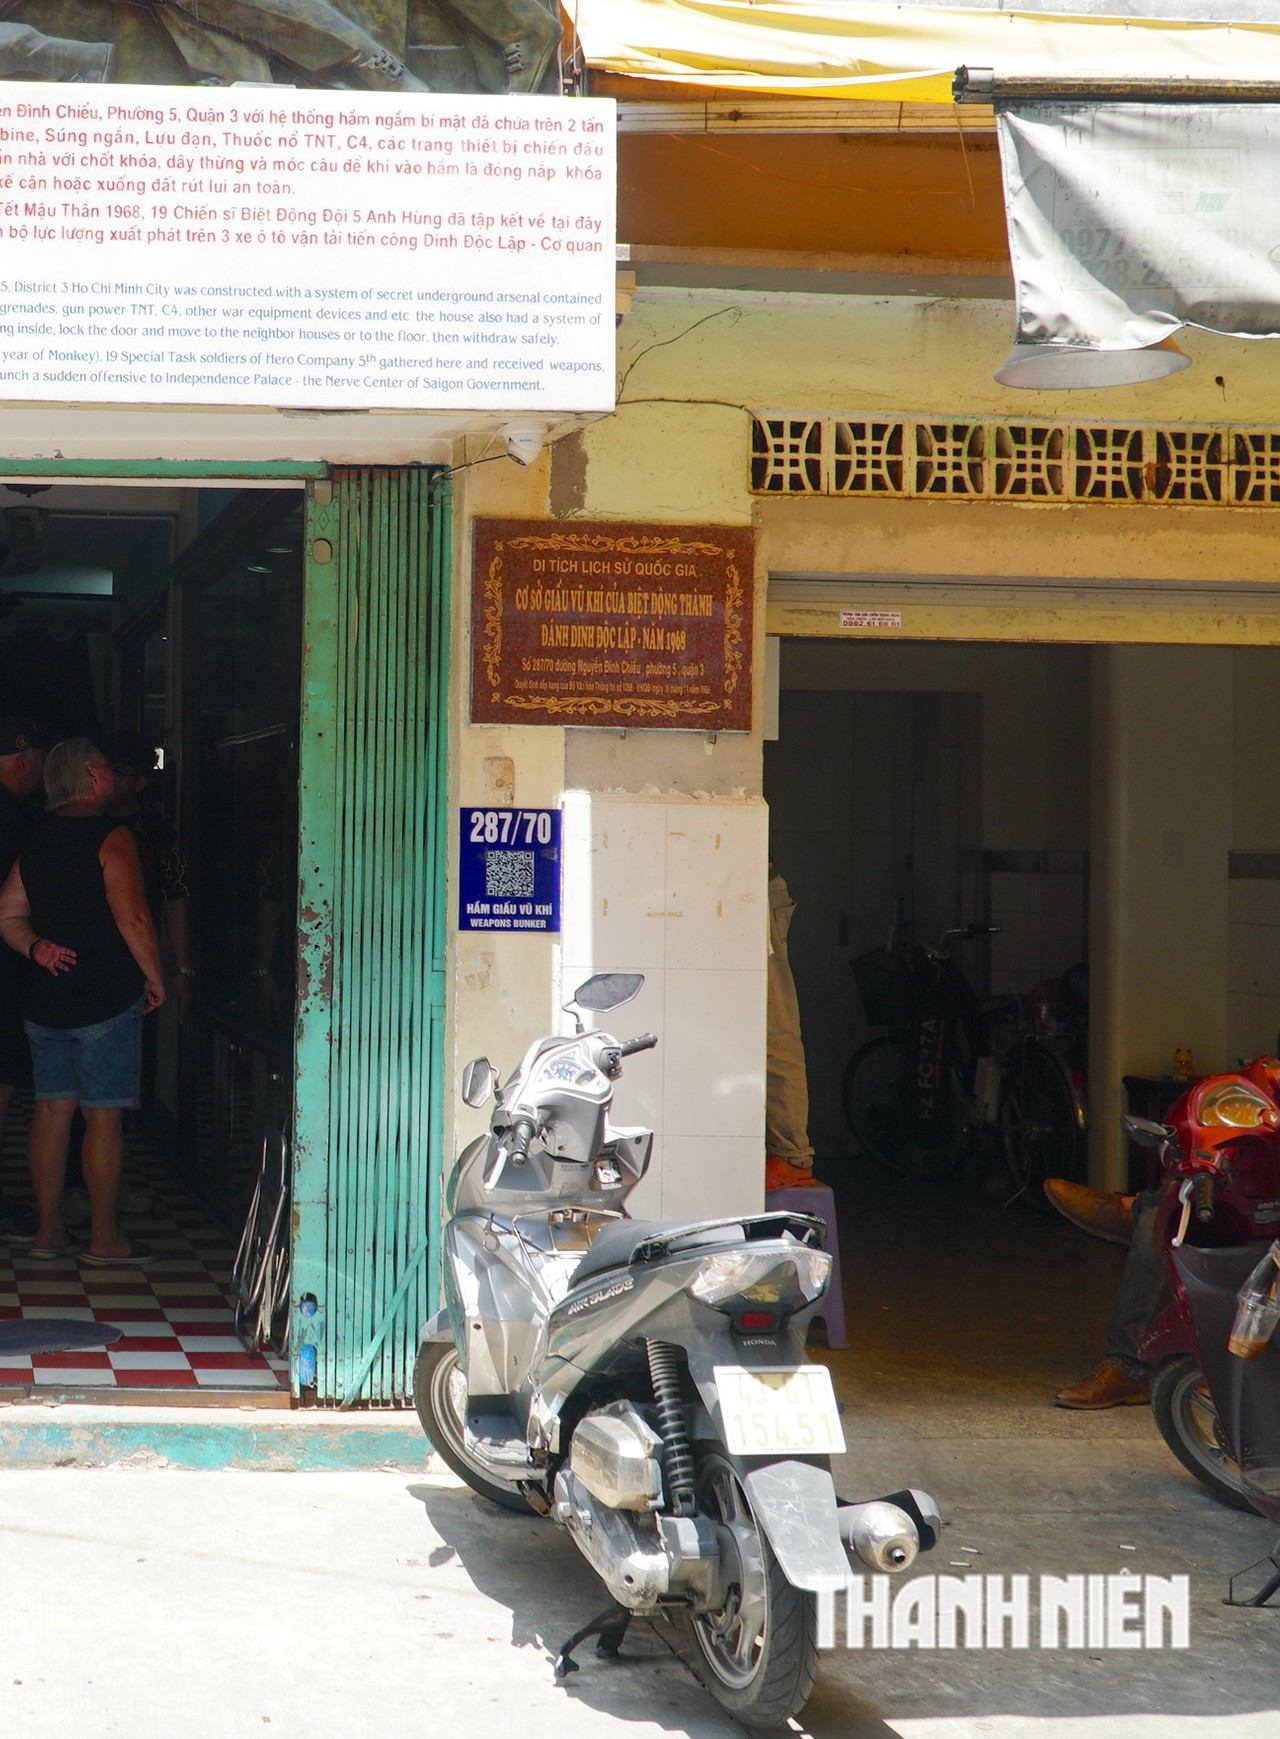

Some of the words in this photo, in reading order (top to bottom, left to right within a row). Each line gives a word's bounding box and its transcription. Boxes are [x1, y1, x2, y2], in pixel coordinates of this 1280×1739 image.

[16, 104, 51, 118] Đình
[55, 102, 103, 120] Chiểu,
[107, 106, 164, 126] Phường
[168, 108, 181, 123] 5,
[186, 107, 225, 125] Quận
[229, 109, 239, 123] 3
[243, 108, 264, 123] với
[269, 110, 287, 127] hệ
[291, 109, 334, 129] thống
[439, 114, 466, 130] mật
[471, 116, 490, 129] đã
[534, 117, 563, 131] trên
[568, 119, 576, 132] 2
[581, 116, 604, 132] tấn
[32, 371, 40, 380] a
[42, 370, 87, 382] sudden
[89, 370, 147, 383] offensive
[149, 371, 163, 383] to
[165, 371, 251, 386] Independence
[253, 373, 293, 385] Palace
[302, 374, 323, 386] the
[325, 375, 361, 387] Nerve
[362, 375, 405, 388] Center
[406, 376, 420, 388] of
[422, 377, 464, 392] Saigon
[466, 377, 545, 390] Government.
[533, 558, 546, 573] DI
[549, 556, 578, 574] TÍCH
[581, 560, 611, 578] LỊCH
[614, 557, 632, 576] SỬ
[635, 557, 672, 577] QUỐC
[675, 563, 697, 578] GIA
[665, 628, 688, 653] 1968
[470, 811, 551, 845] 287/70
[535, 903, 553, 915] KHÍ
[470, 918, 511, 928] WEAPONS
[513, 919, 547, 928] BUNKER
[742, 1339, 777, 1347] HONDA
[733, 1412, 835, 1447] 154.51
